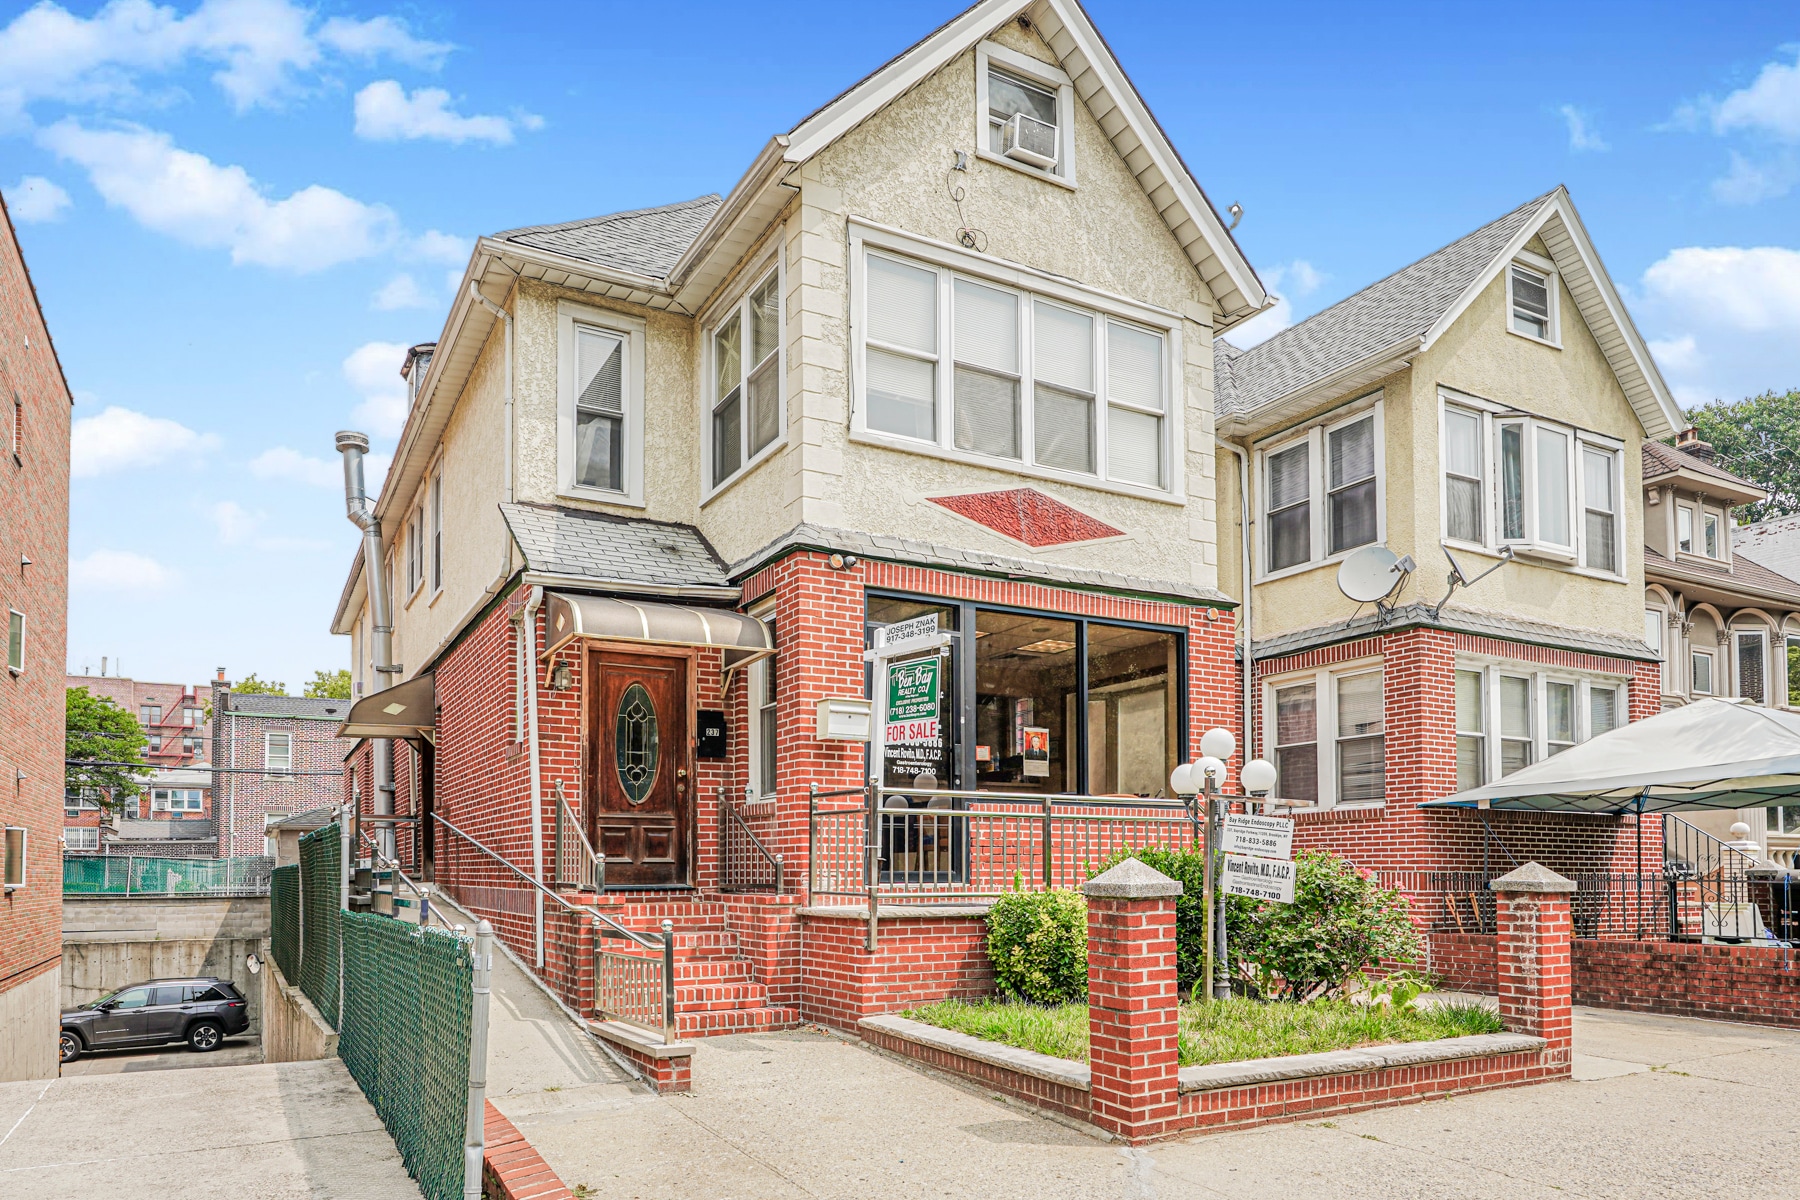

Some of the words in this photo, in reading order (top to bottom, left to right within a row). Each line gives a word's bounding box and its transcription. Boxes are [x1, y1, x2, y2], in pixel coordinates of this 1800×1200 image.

[886, 623, 914, 636] JOSEPH
[915, 617, 936, 629] ZNAK
[886, 625, 936, 643] 917-348-3199
[898, 669, 913, 688] Ben
[915, 666, 933, 694] Bay
[898, 687, 917, 696] REALTY
[890, 706, 905, 716] (718)
[905, 702, 936, 714] 238-6080
[706, 728, 719, 736] 237
[886, 725, 906, 742] FOR
[909, 721, 937, 740] SALE
[885, 747, 901, 759] Vincent
[892, 766, 936, 775] 718-748-7100
[1237, 818, 1250, 826] Ridge
[1251, 819, 1275, 828] Endoscopy
[1275, 821, 1289, 829] PLLC
[1235, 835, 1277, 847] 718-833-5886
[1228, 859, 1244, 873] Vincent
[1244, 861, 1259, 877] Rovito,
[1272, 864, 1290, 880] F.A.C.P.
[1230, 885, 1281, 899] 718-748-7100
